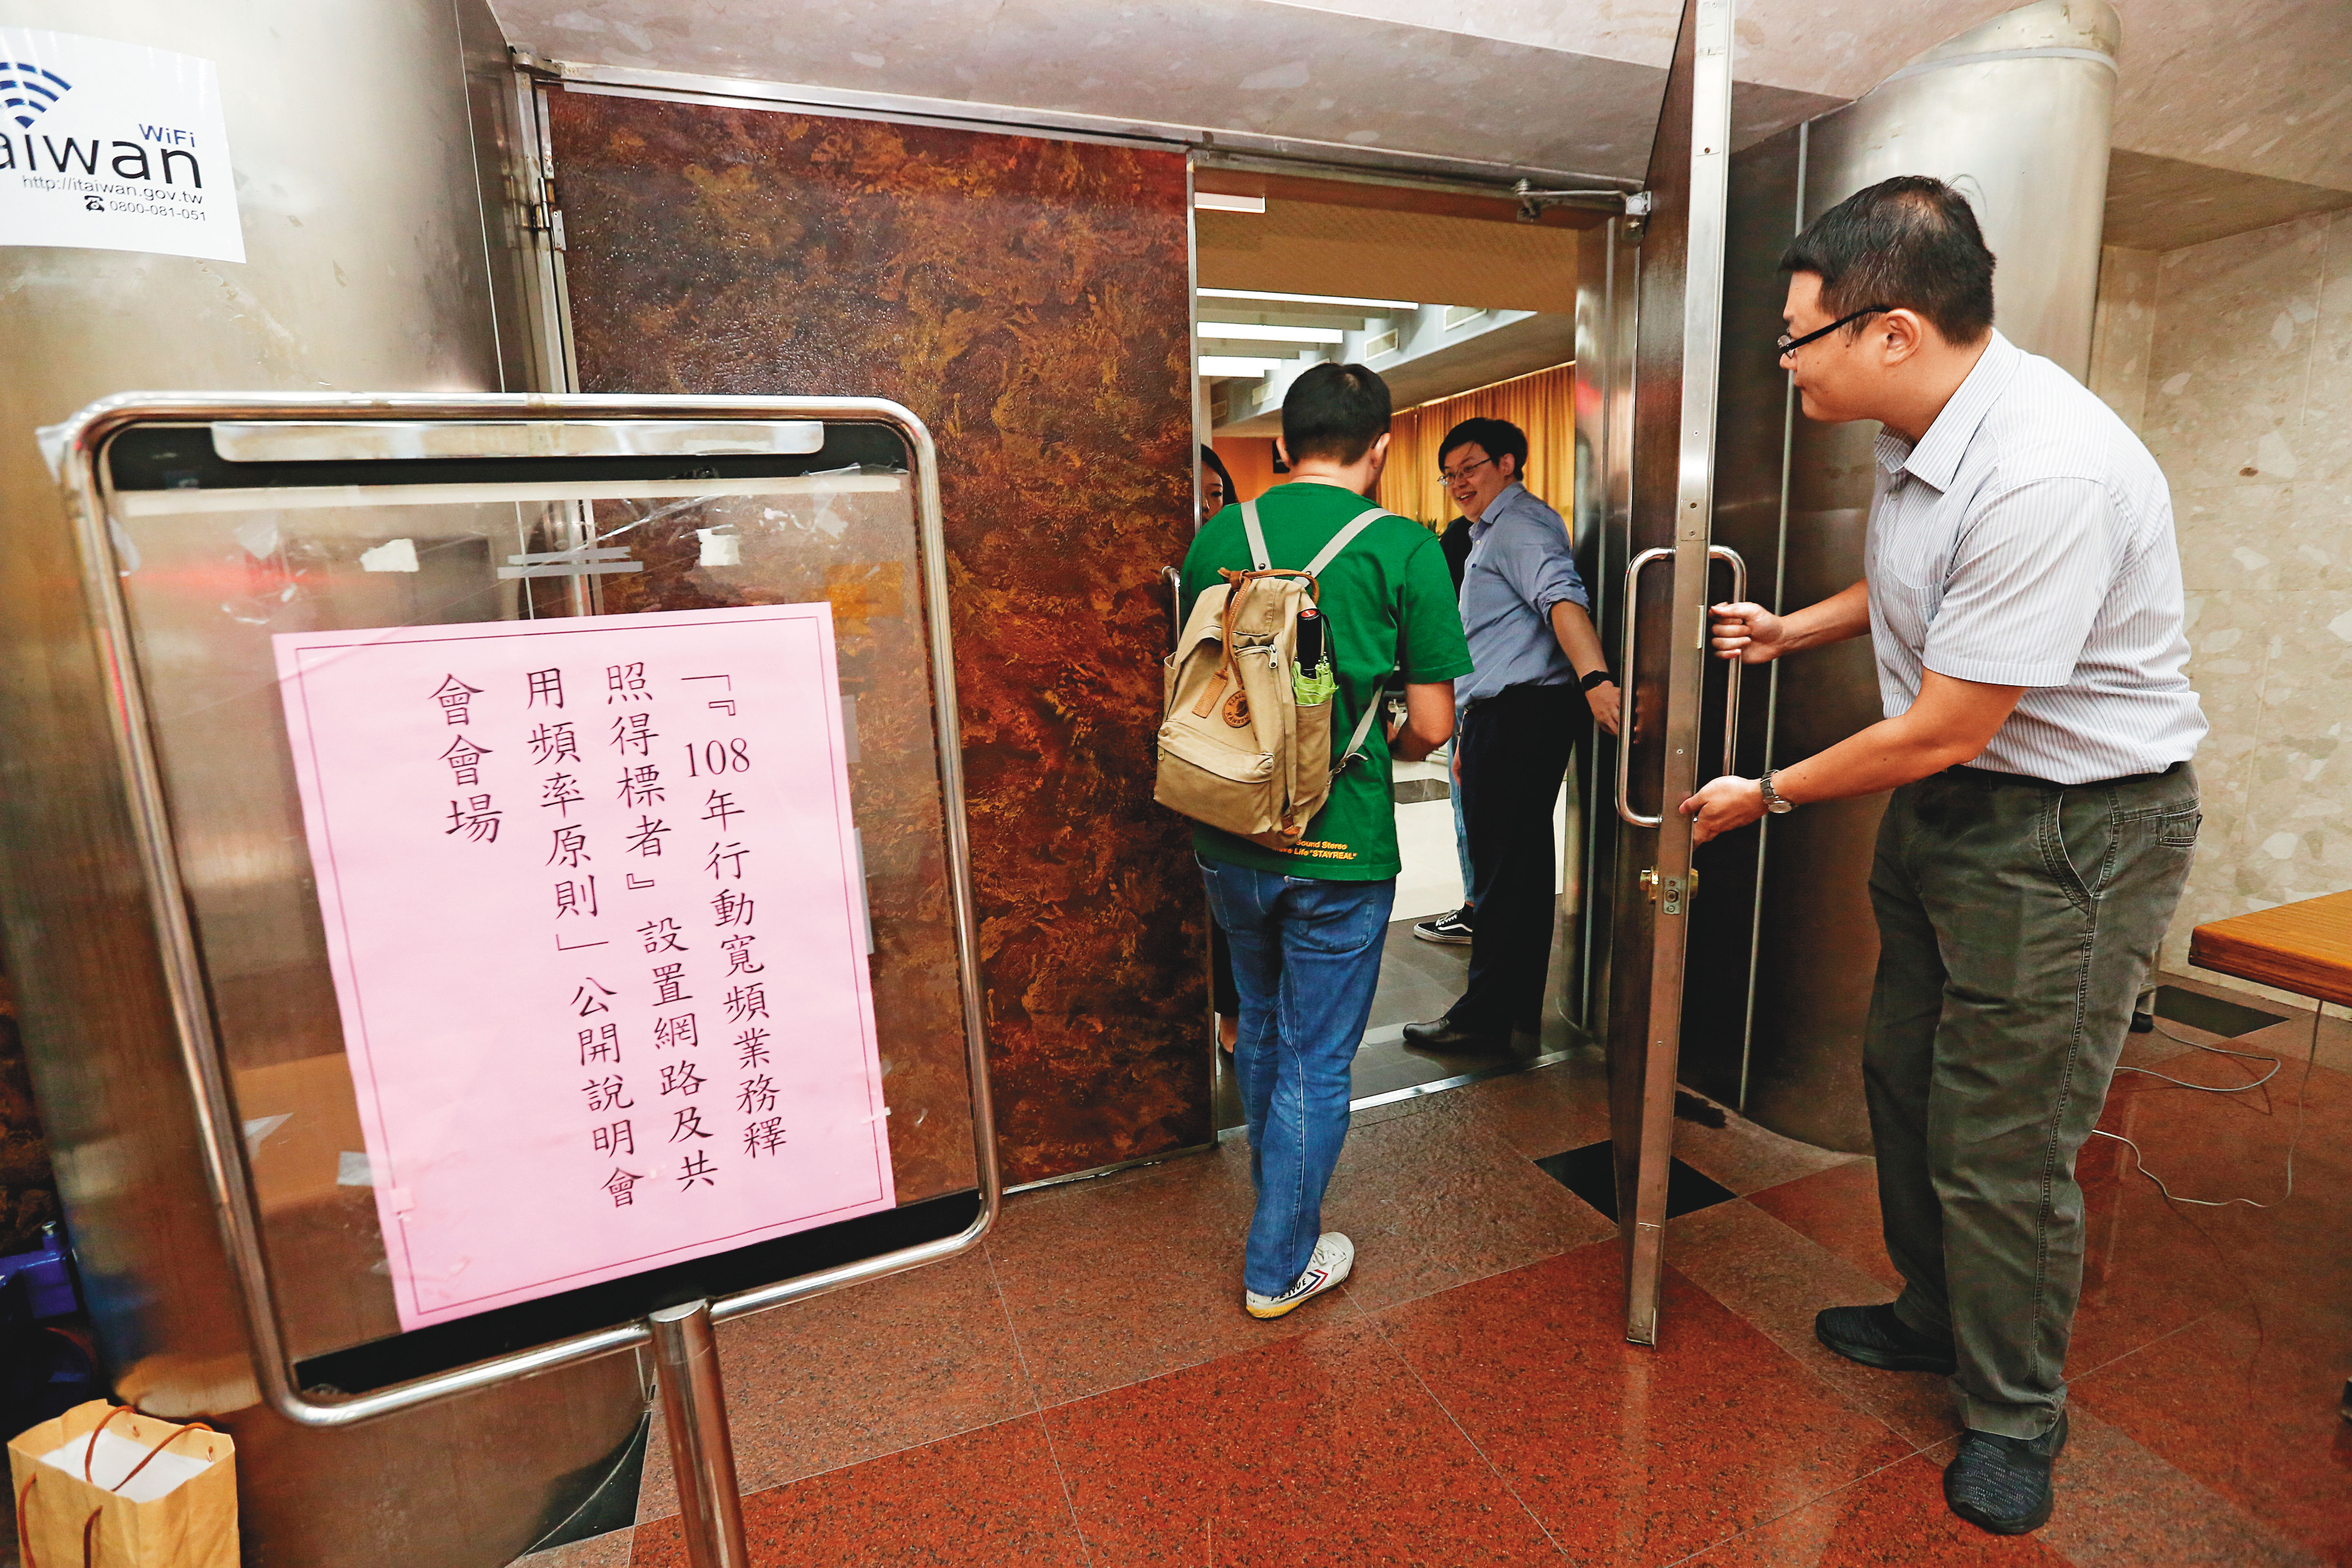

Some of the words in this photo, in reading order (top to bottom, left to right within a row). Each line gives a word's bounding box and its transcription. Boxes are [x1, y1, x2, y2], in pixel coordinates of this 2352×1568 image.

[139, 123, 195, 147] WiFi
[22, 175, 203, 204] http://itaiwan.gov.tw
[110, 200, 206, 221] 0800-081-051
[428, 673, 503, 844] 會會場
[1294, 848, 1310, 856] Life
[1310, 850, 1358, 860] "STAYREAL"
[1321, 841, 1348, 850] Stereo
